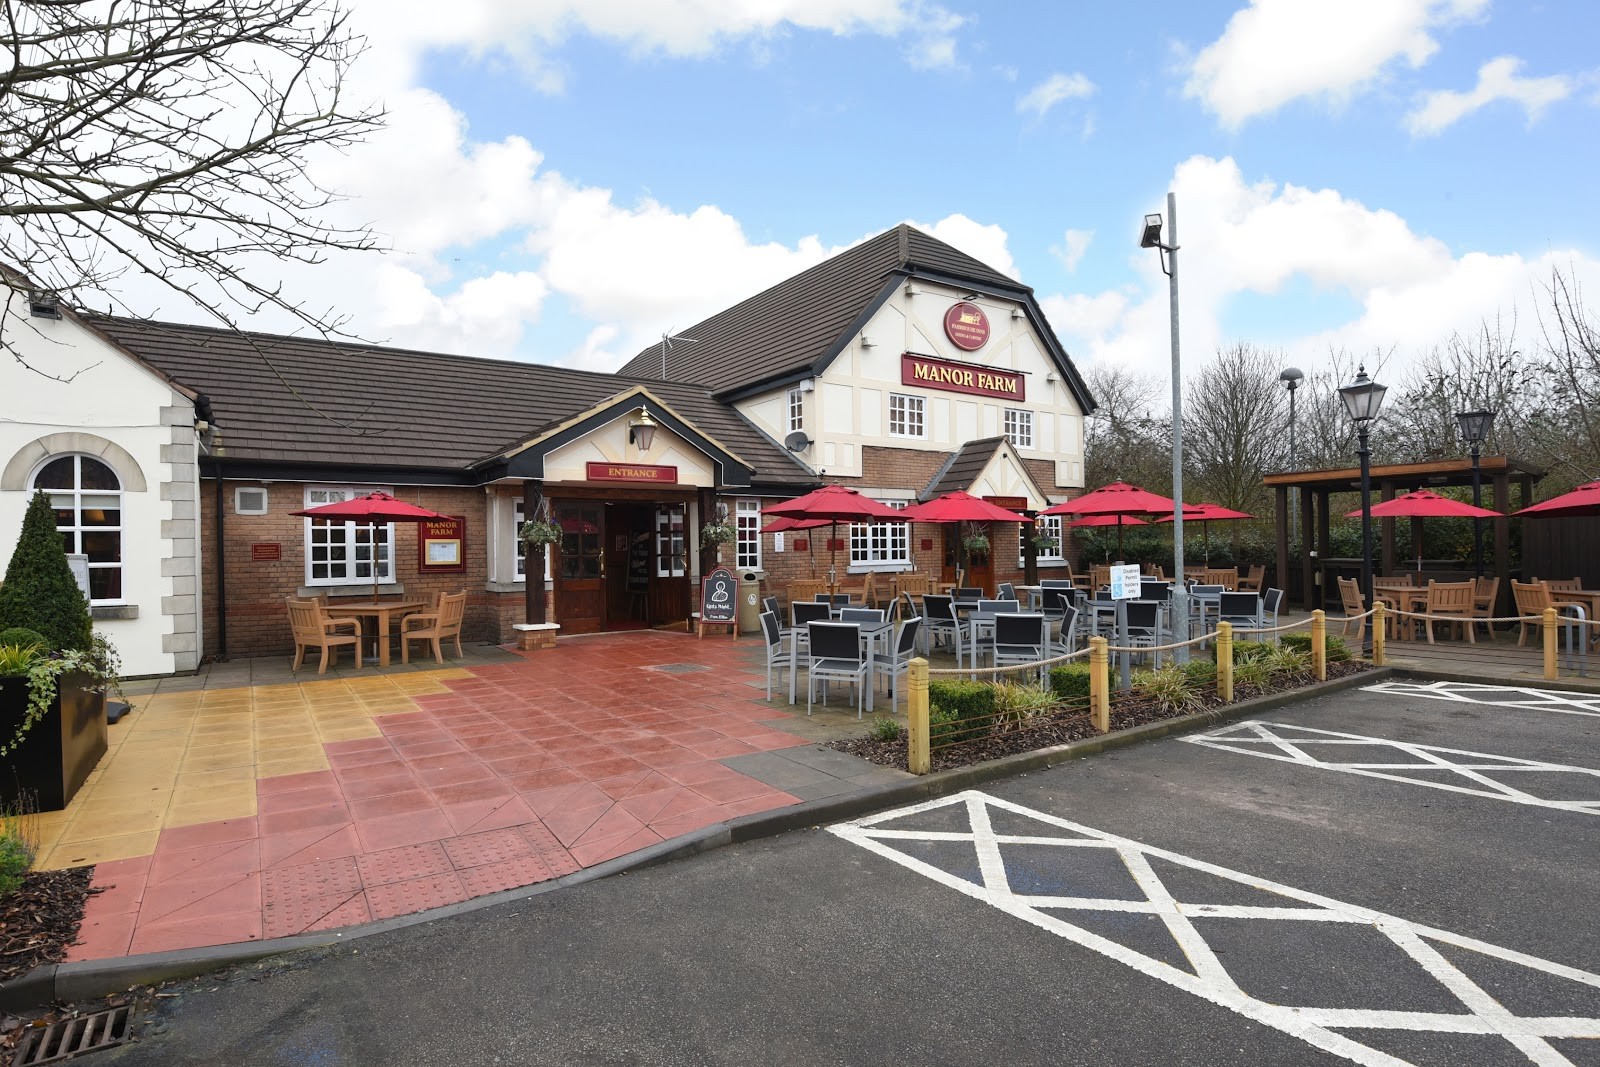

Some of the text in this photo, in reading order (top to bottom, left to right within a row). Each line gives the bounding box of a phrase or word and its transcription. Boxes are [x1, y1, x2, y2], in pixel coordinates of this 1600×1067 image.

[914, 362, 1017, 393] MANOR FARM
[608, 467, 658, 478] ENTRANCE
